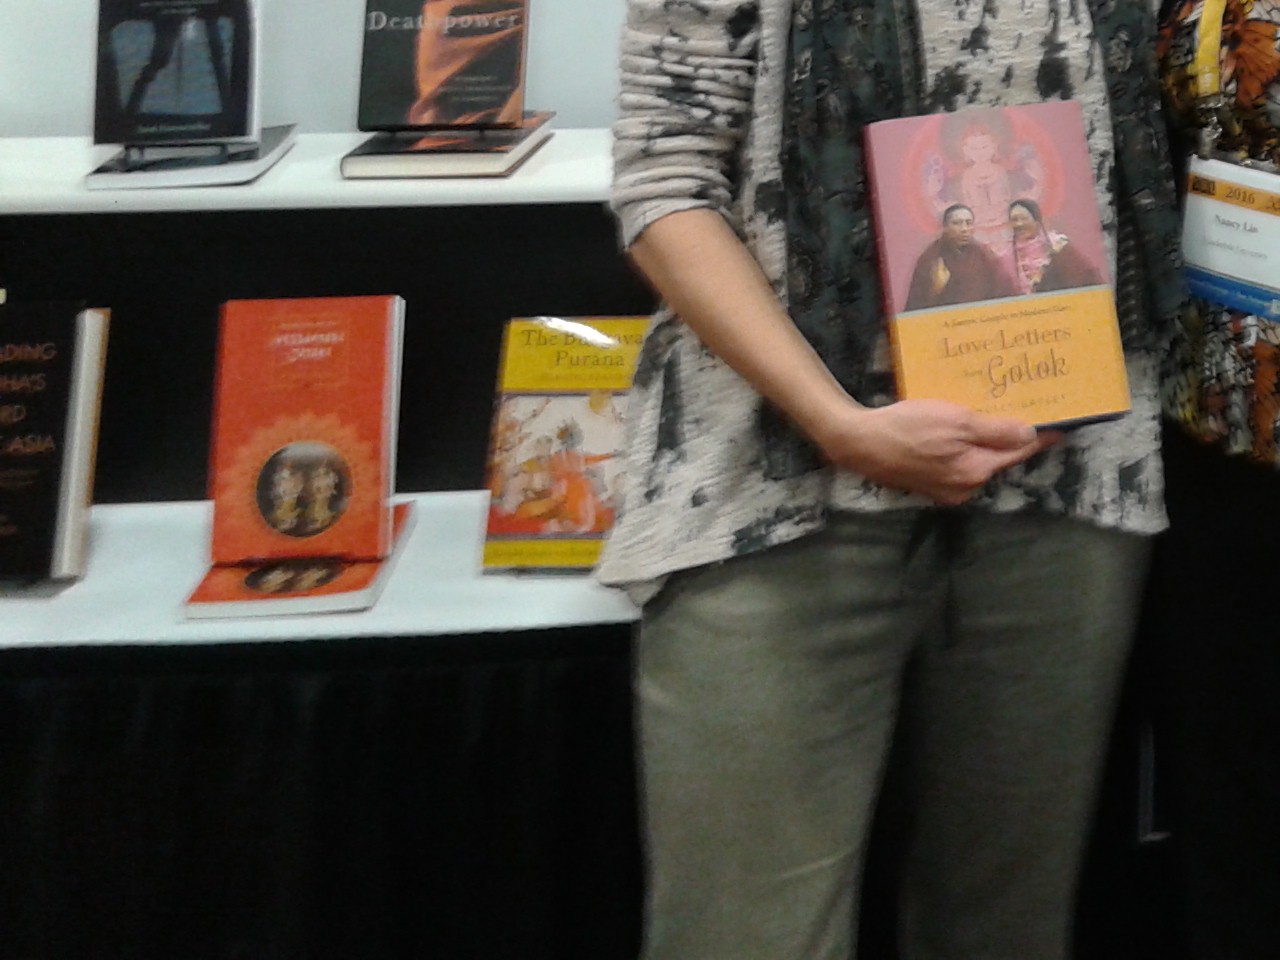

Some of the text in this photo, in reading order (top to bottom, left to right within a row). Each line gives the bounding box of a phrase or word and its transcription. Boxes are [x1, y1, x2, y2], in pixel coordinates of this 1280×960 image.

[1225, 187, 1256, 205] 2016
[942, 328, 1072, 358] Love Letters
[555, 351, 625, 367] Purana
[988, 348, 1070, 399] Golok
